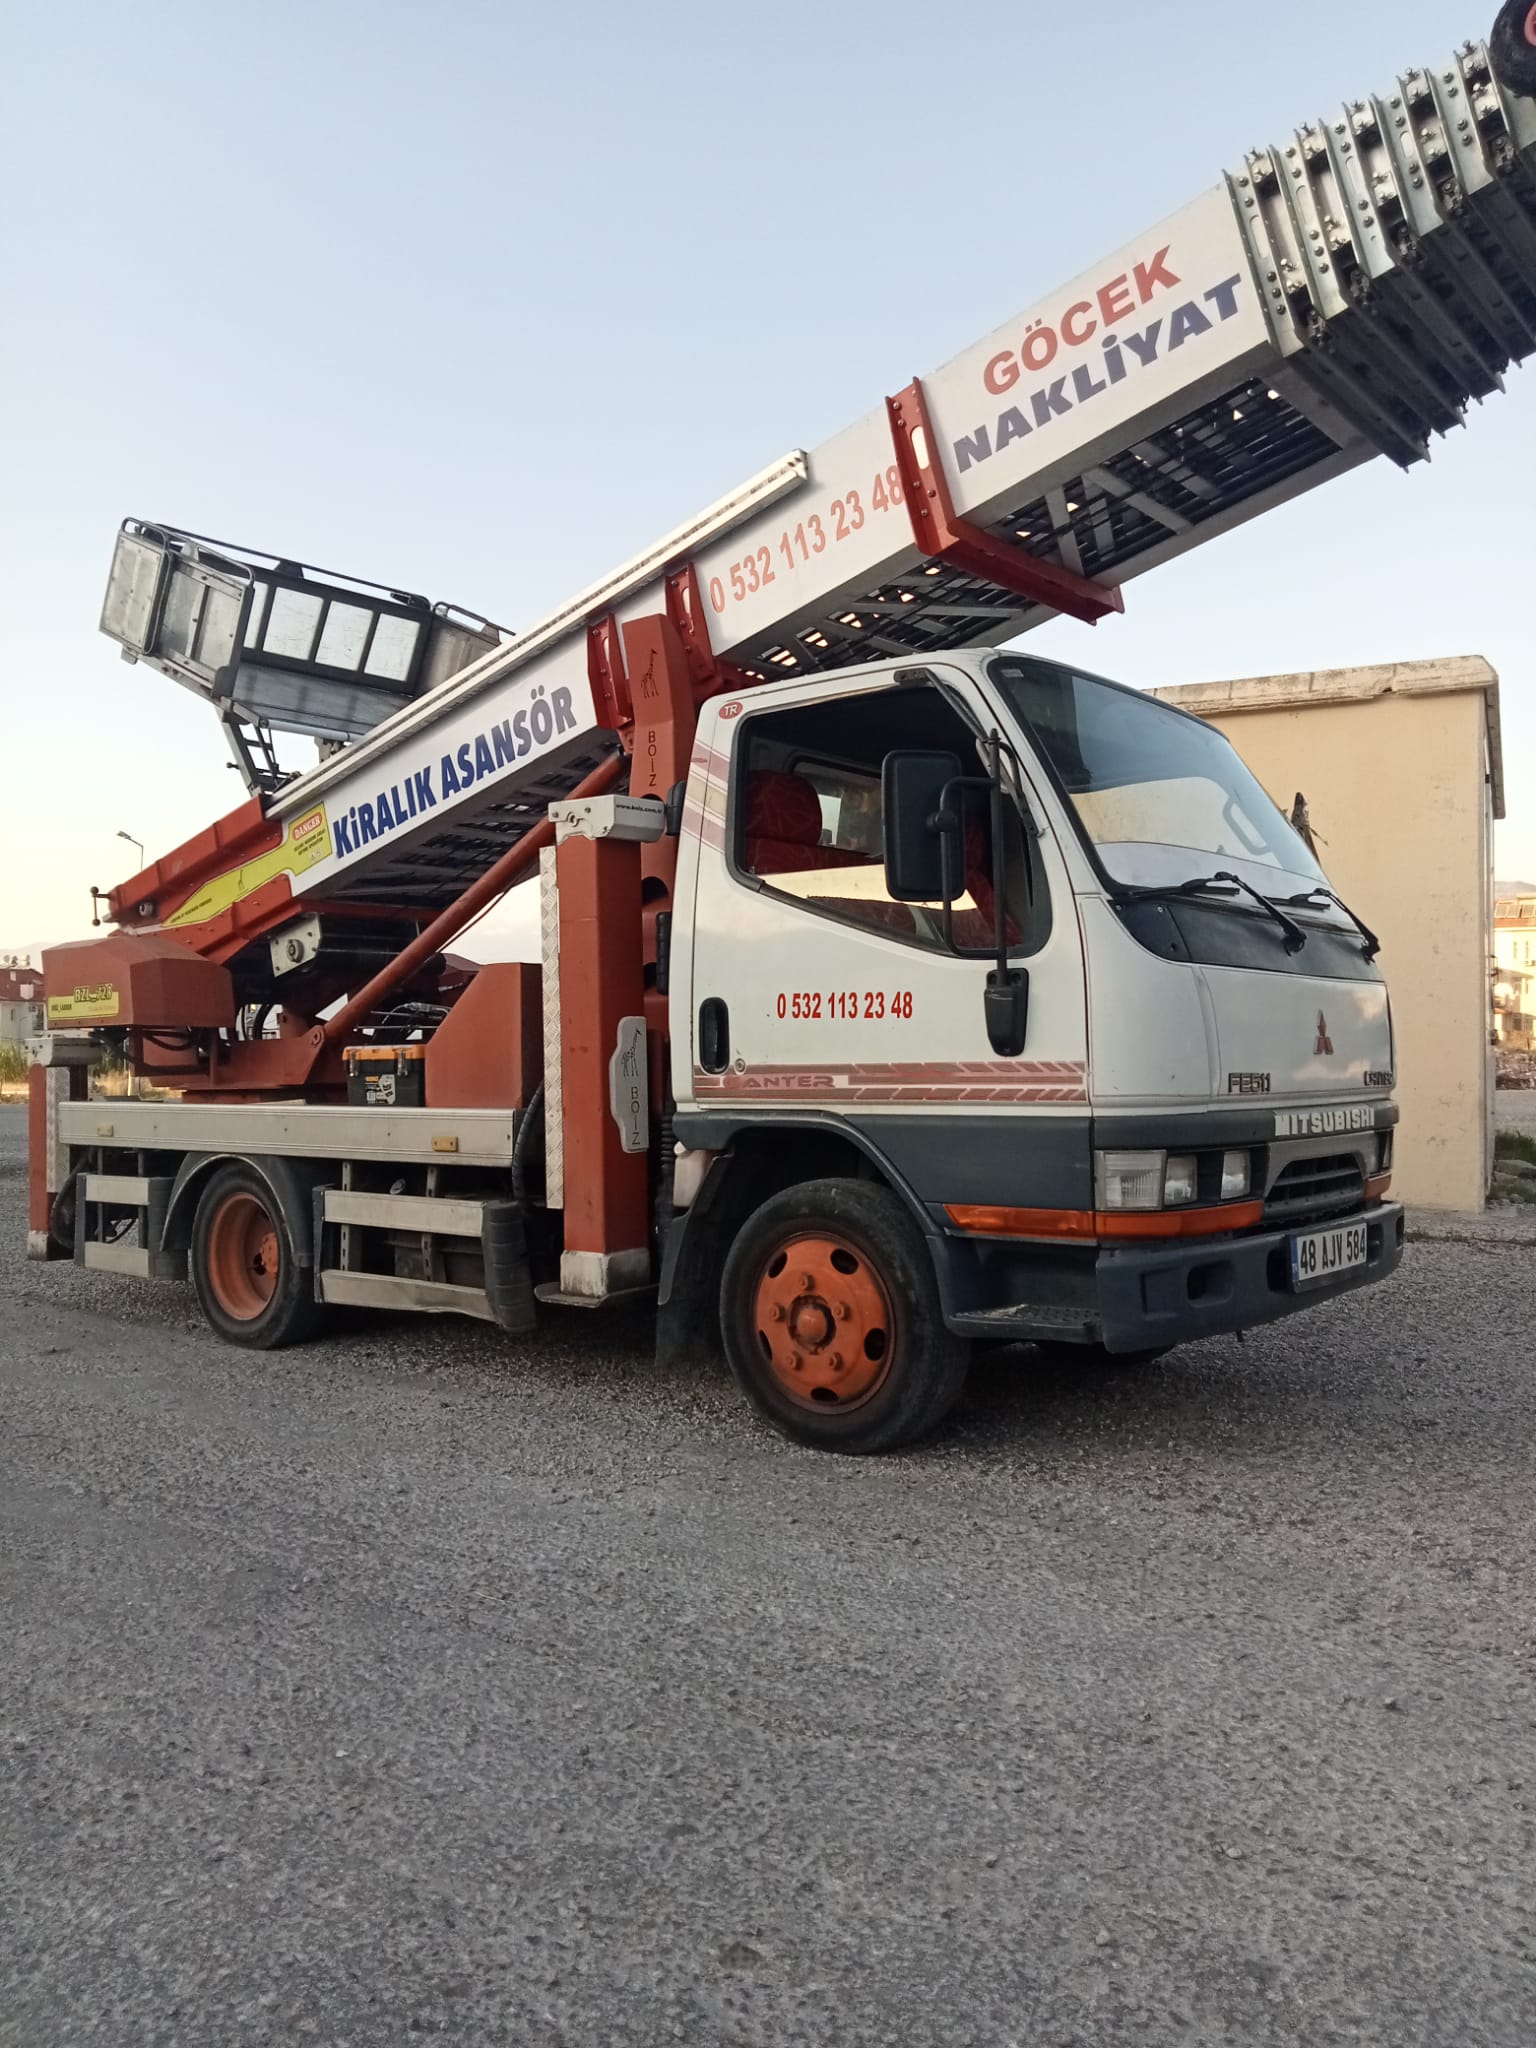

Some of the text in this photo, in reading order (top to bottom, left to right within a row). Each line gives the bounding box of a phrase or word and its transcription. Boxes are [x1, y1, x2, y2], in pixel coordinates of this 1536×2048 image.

[983, 244, 1182, 395] GÖCEK
[709, 465, 904, 613] 0 532 113 23 48
[723, 704, 738, 716] TR
[441, 685, 577, 800] ASANSÖR
[777, 991, 912, 1019] 0 532 113 23 48
[1274, 1107, 1375, 1136] MITSUBISHI
[1301, 1239, 1316, 1274] 48
[1347, 1228, 1366, 1262] 584
